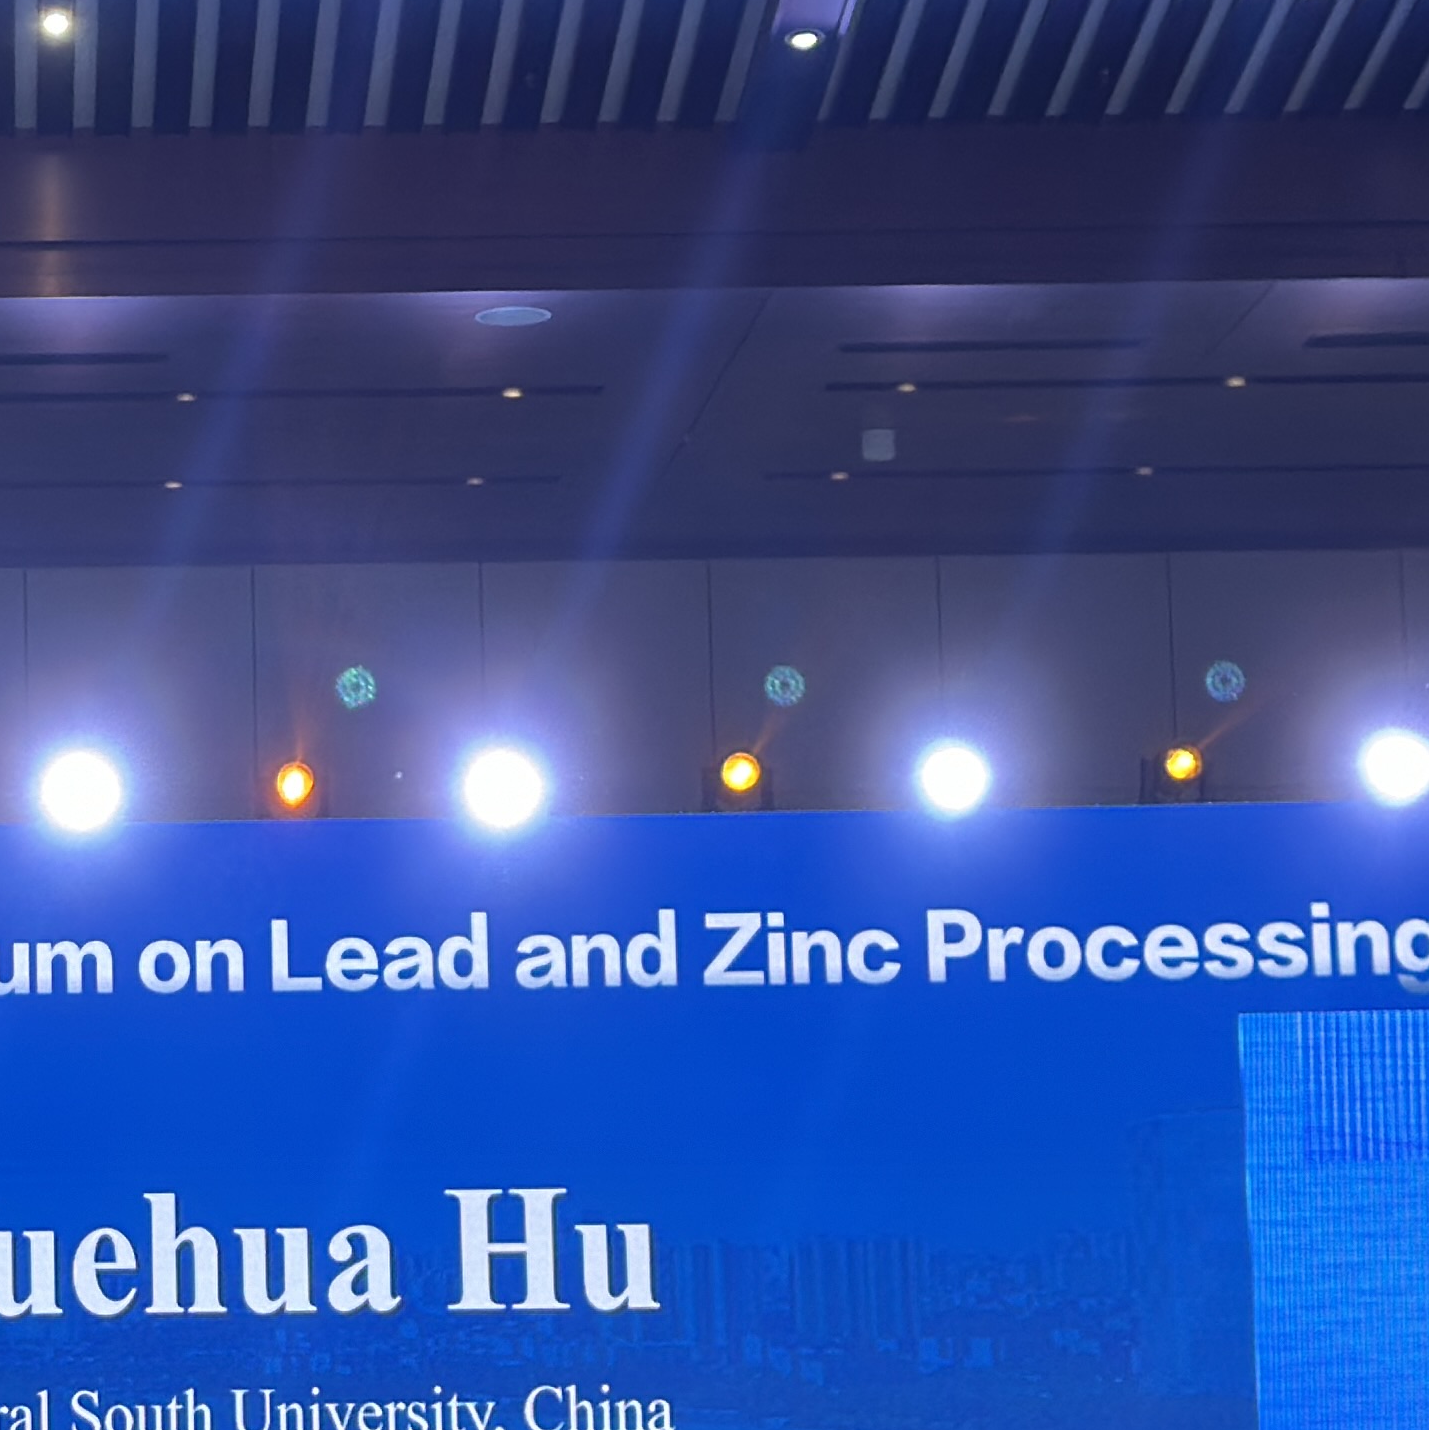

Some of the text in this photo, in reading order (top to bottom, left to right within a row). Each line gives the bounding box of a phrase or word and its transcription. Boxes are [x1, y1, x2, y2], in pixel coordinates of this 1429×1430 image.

[138, 938, 245, 993] on
[271, 911, 489, 992] Lead
[515, 908, 678, 989] and
[703, 912, 901, 986] Zinc
[444, 1188, 662, 1311] Hu
